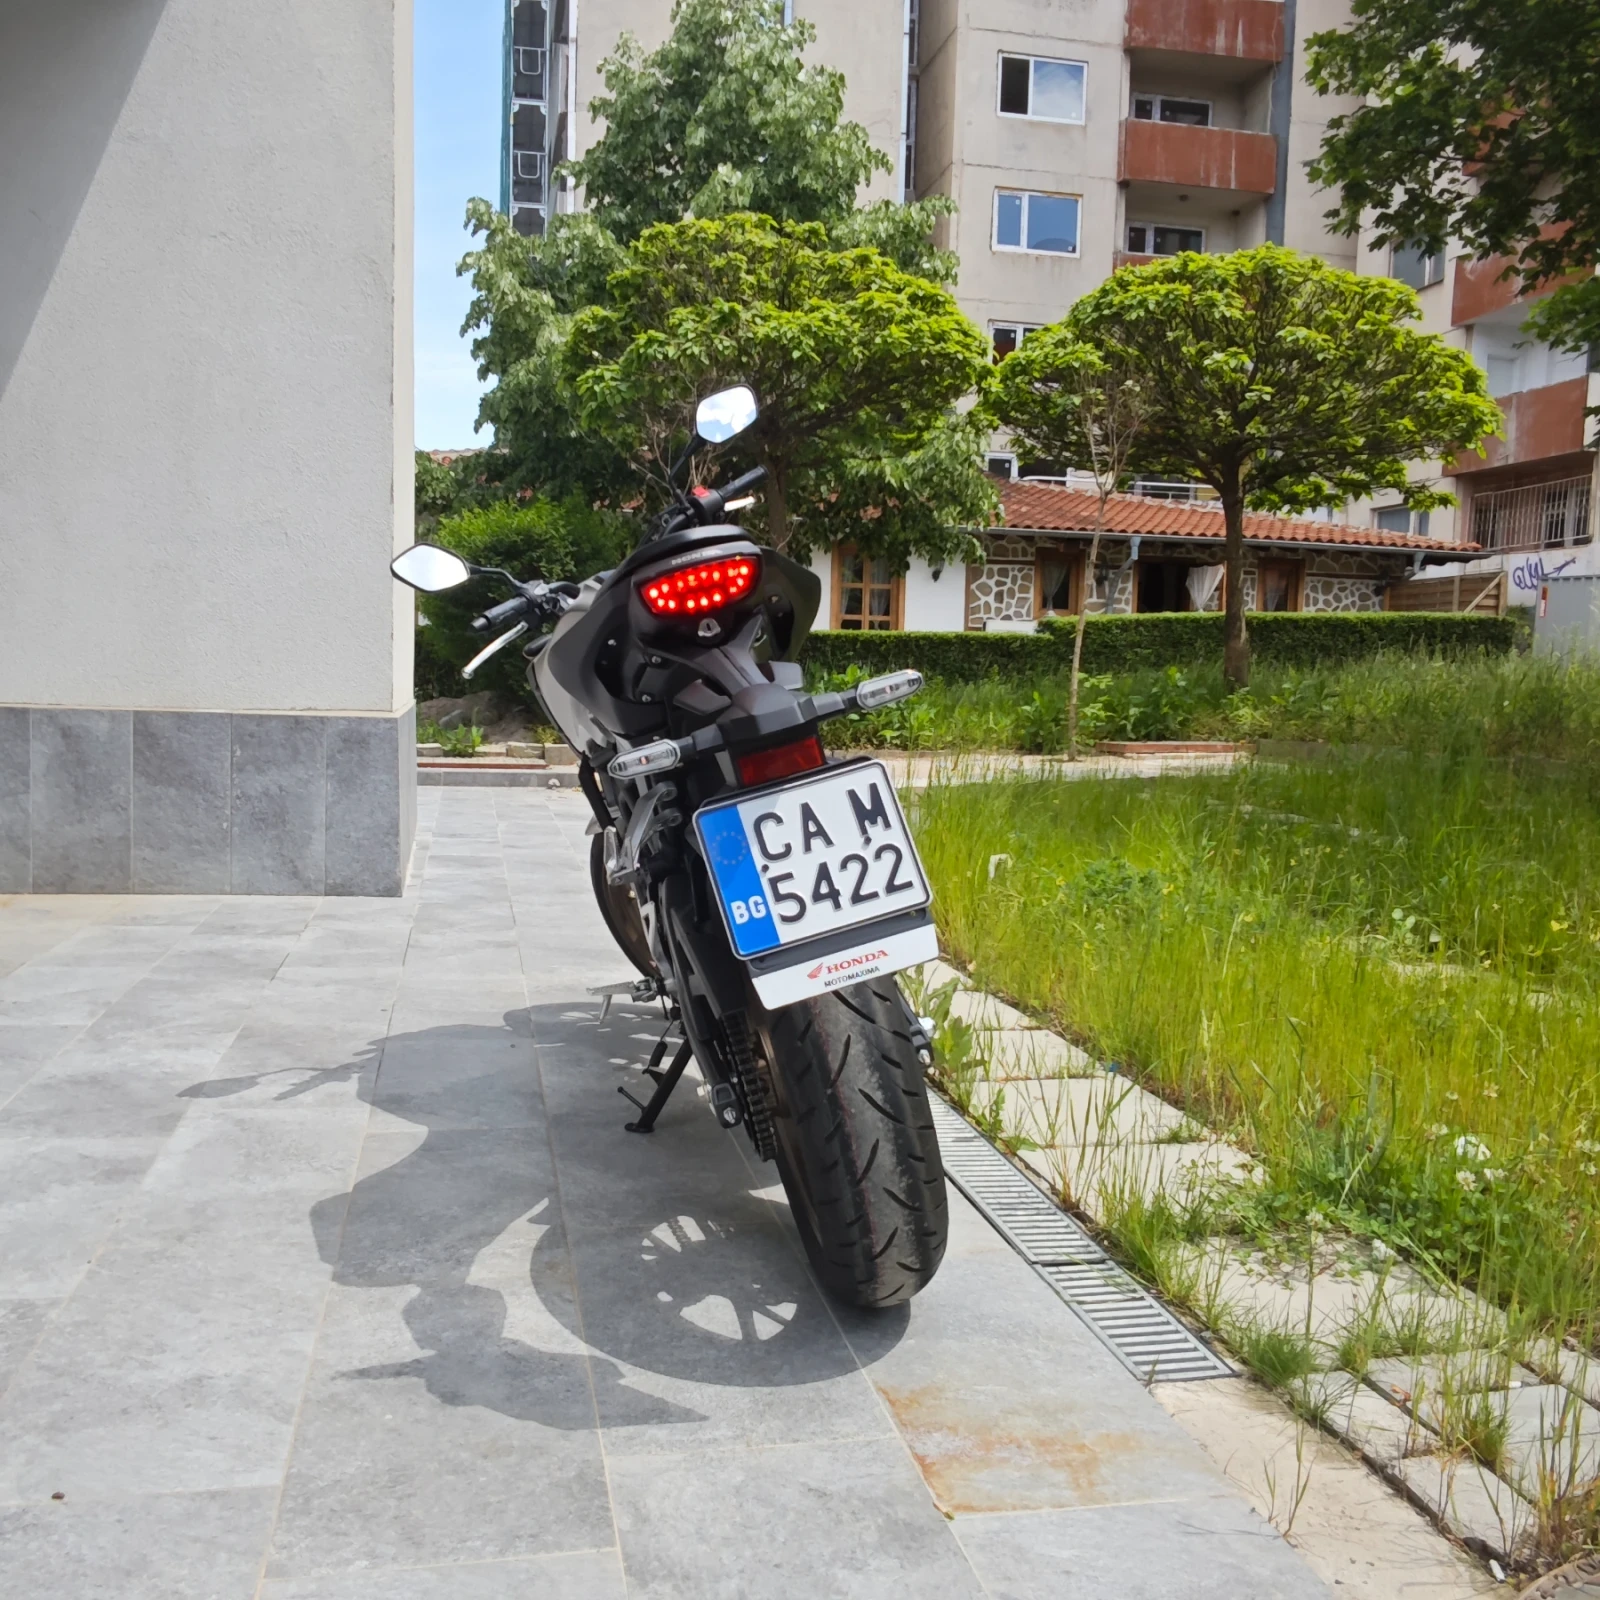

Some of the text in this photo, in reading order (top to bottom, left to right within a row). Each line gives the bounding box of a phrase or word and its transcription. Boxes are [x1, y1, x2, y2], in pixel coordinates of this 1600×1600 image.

[753, 782, 892, 861] CA M
[768, 843, 914, 923] 5422
[730, 895, 767, 925] BG
[824, 966, 880, 987] MOTOMAXIMA
[826, 950, 889, 974] HONDA
